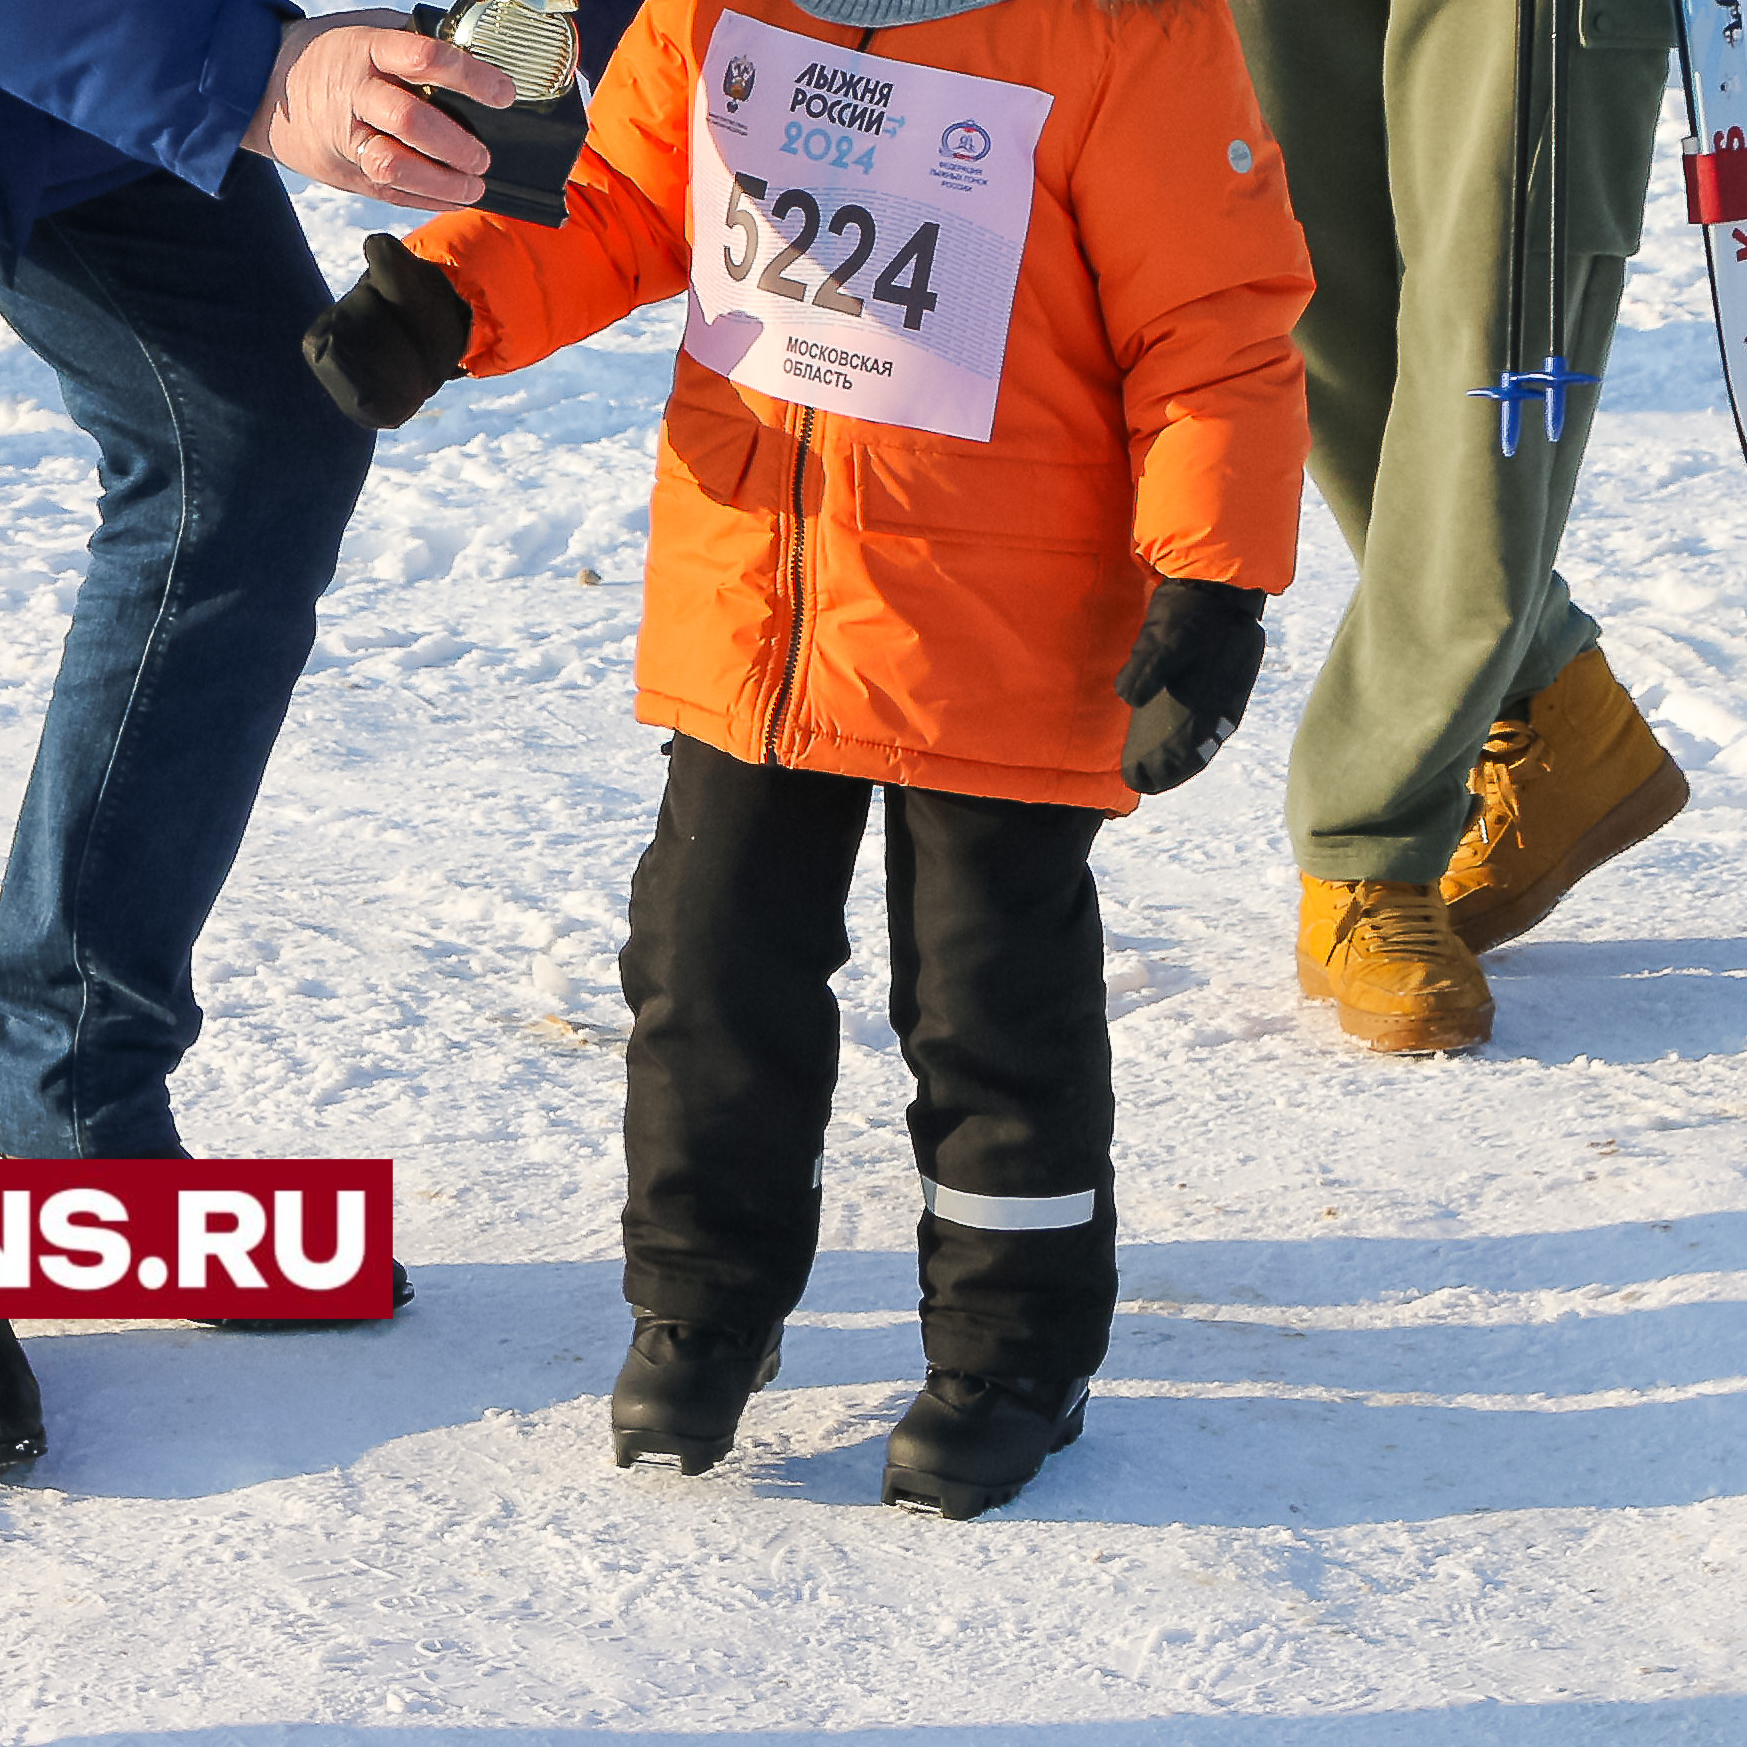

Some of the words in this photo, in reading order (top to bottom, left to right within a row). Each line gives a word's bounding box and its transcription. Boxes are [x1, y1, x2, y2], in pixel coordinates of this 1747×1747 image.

[794, 62, 894, 108] ЛЫЖНЯ
[789, 87, 886, 136] РОССИИ
[778, 120, 877, 175] 2024
[724, 171, 941, 331] 5224
[783, 357, 853, 390] ОБЛАСТЬ
[786, 335, 893, 378] МОСКОВСКАЯ
